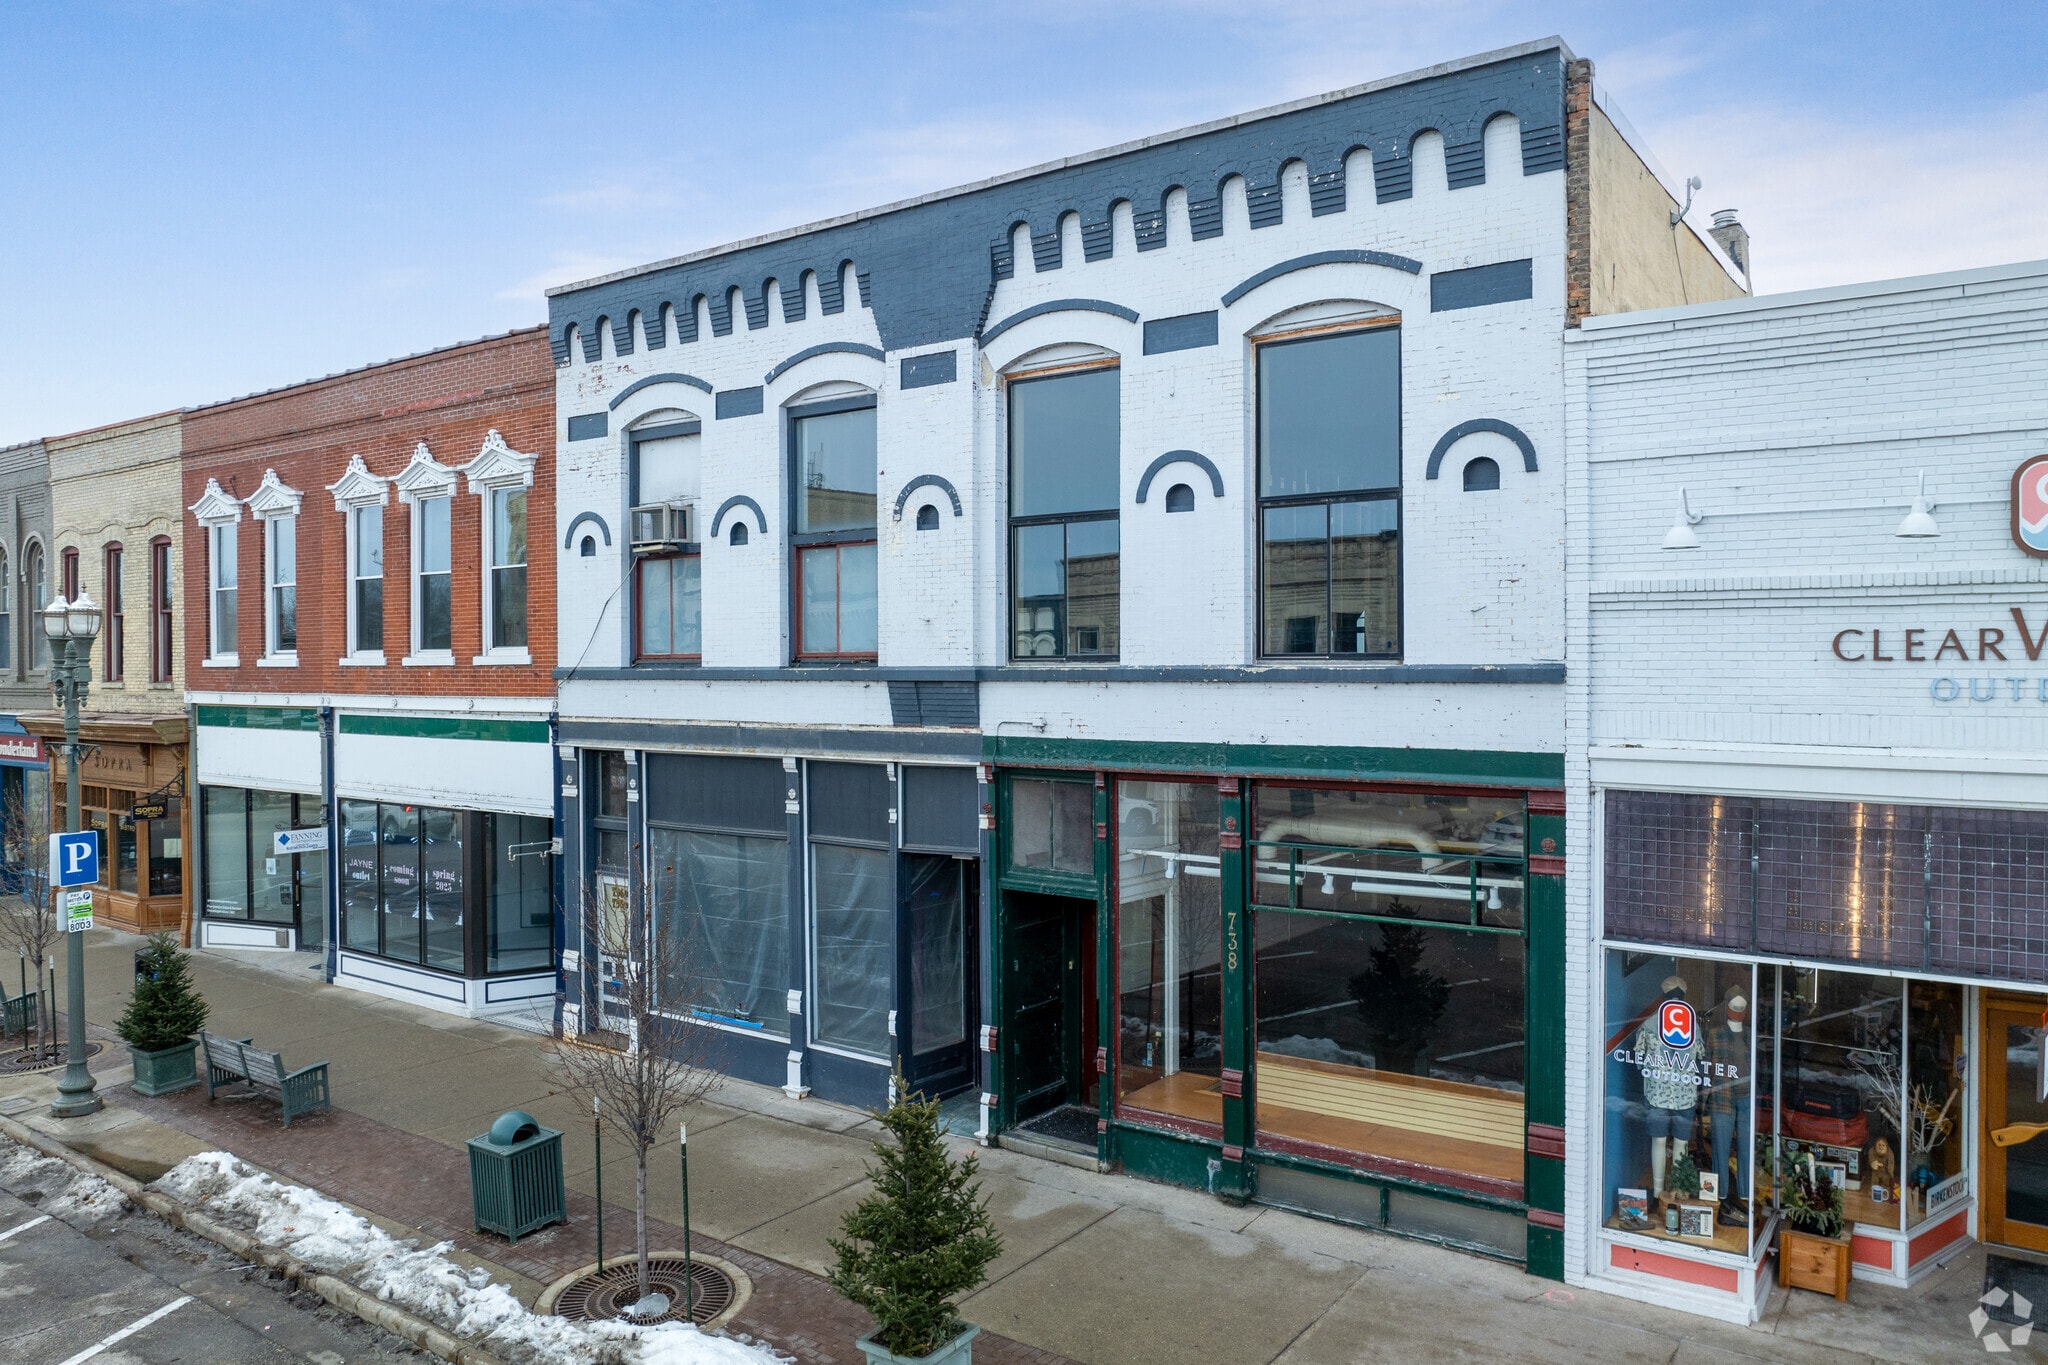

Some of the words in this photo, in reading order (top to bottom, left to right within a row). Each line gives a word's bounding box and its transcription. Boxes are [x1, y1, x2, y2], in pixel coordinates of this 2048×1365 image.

[94, 756, 132, 771] SOPRA
[134, 806, 164, 815] SOPRA
[290, 831, 322, 841] FANNING
[65, 842, 92, 874] P
[349, 858, 374, 870] JAYNE
[352, 871, 370, 881] outlet
[389, 865, 414, 877] coming
[432, 869, 456, 882] spring
[394, 877, 410, 886] soon
[435, 881, 452, 892] 2025
[70, 920, 92, 931] 8003
[1227, 912, 1238, 970] 738
[1641, 1068, 1712, 1087] OUTDOOR
